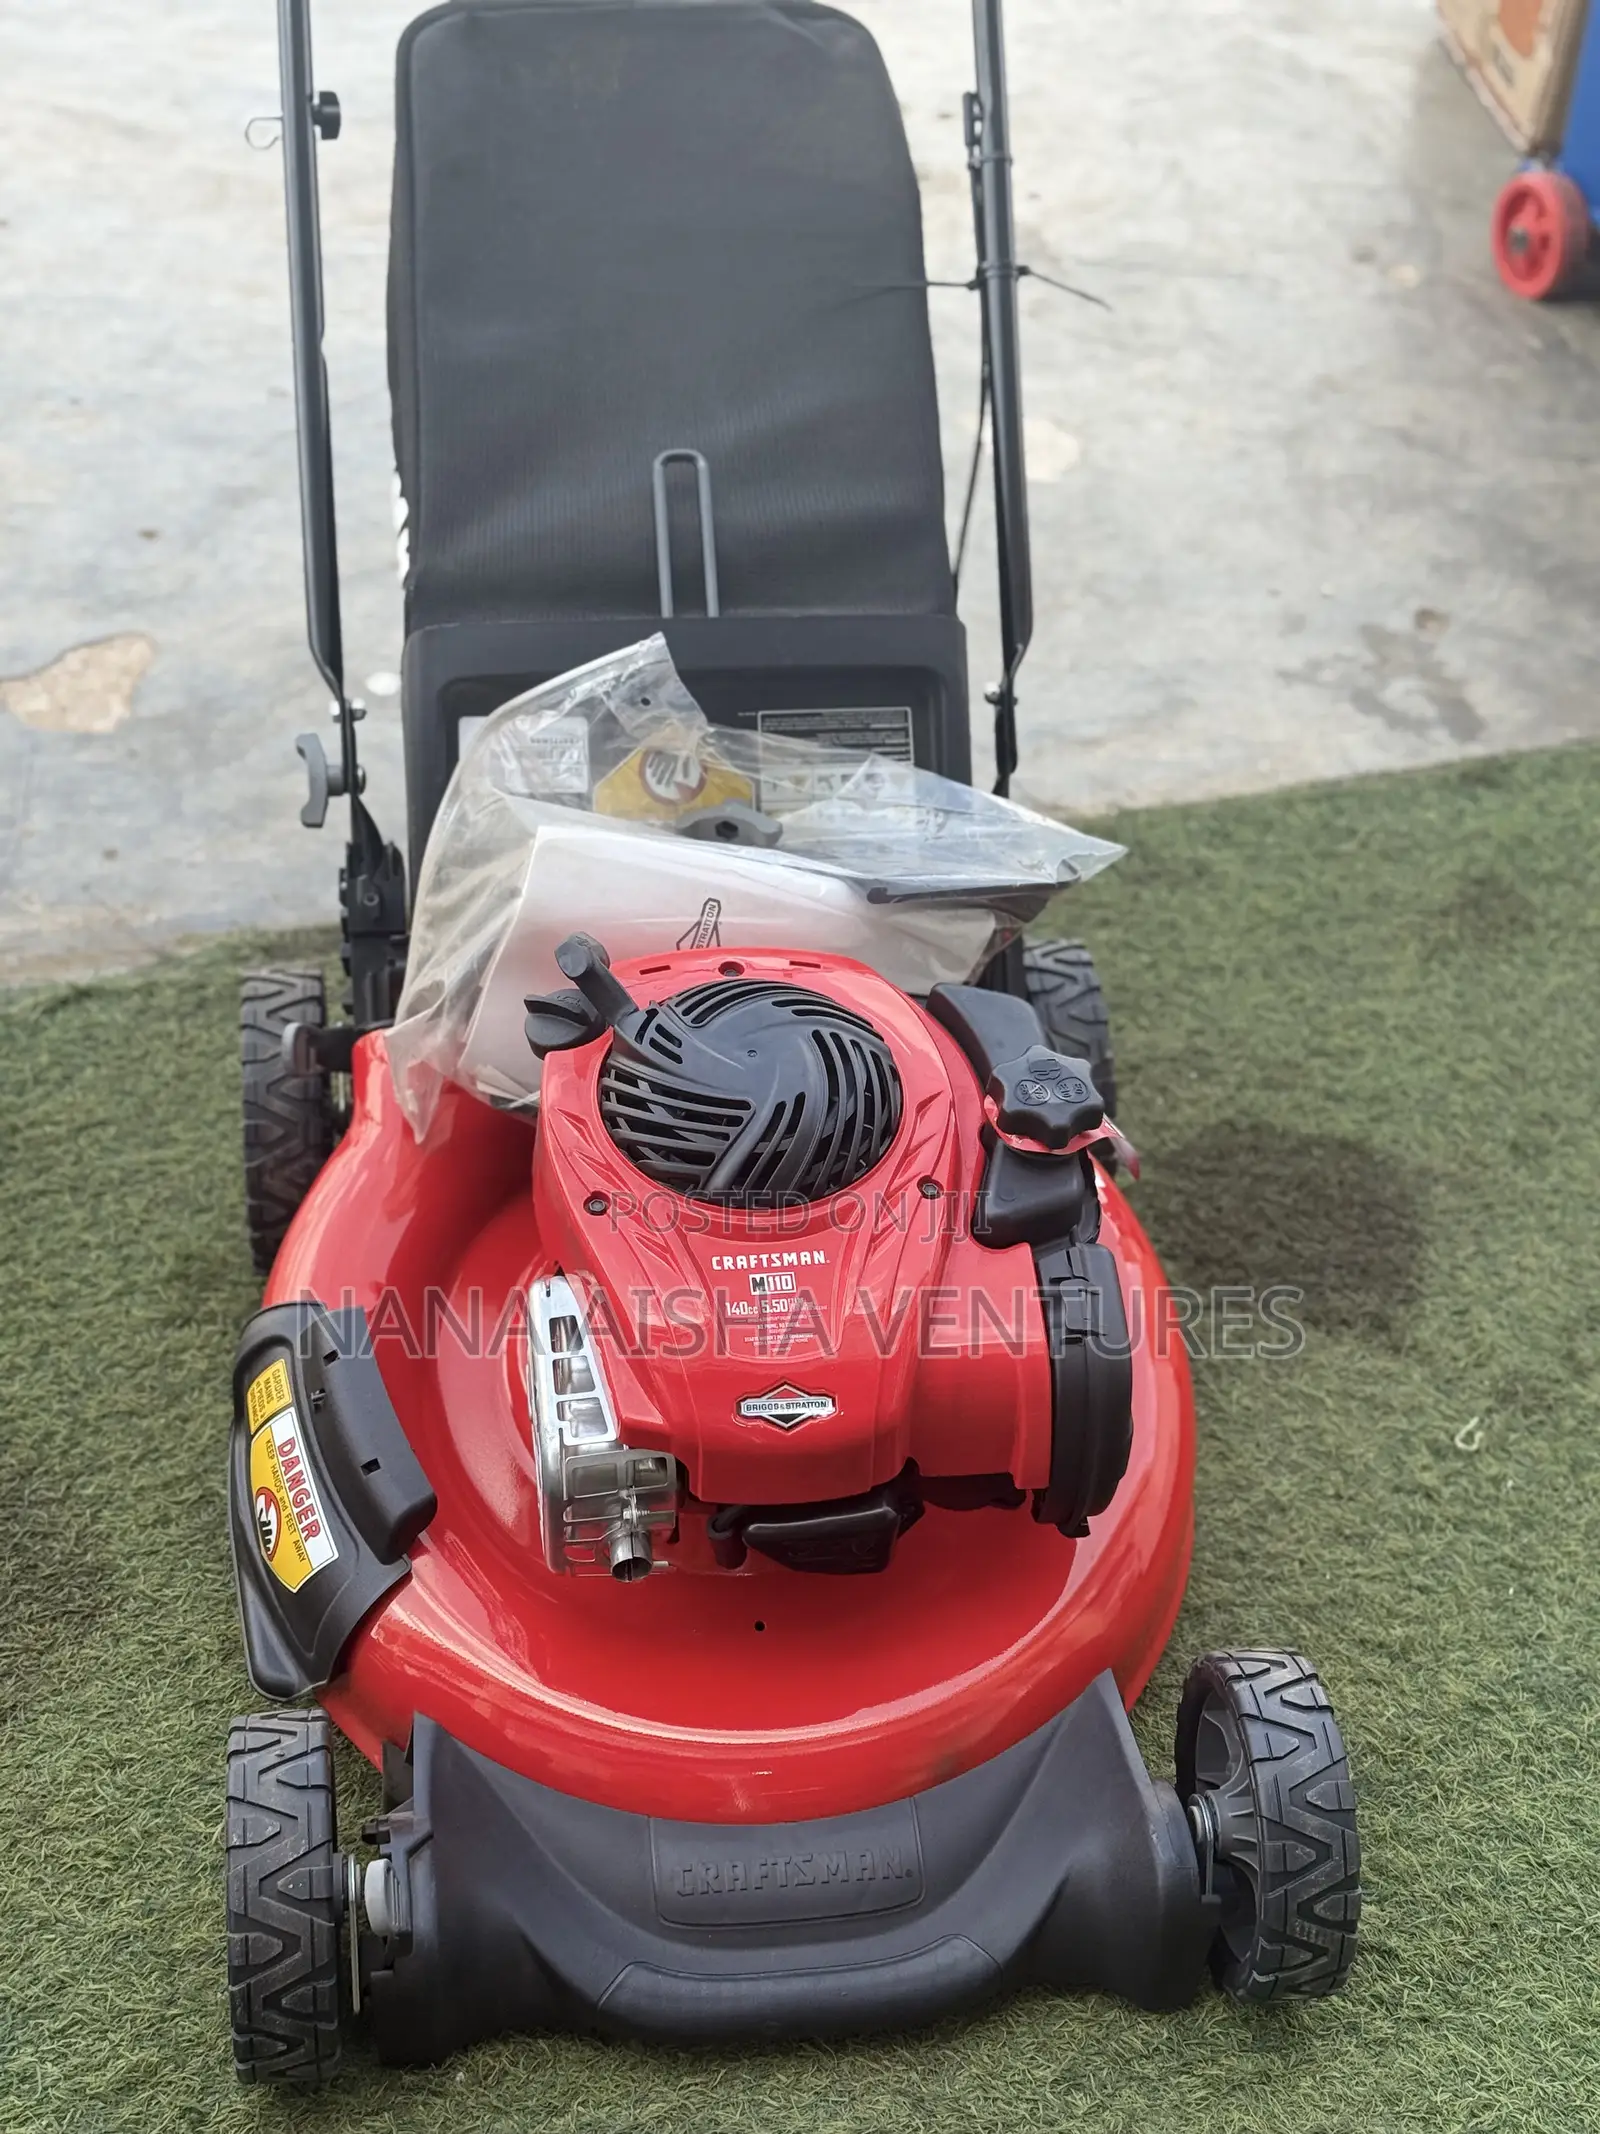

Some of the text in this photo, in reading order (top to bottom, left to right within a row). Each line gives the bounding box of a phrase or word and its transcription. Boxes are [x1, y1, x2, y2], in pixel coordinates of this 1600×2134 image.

[711, 1250, 827, 1271] CRAFTSMAN
[751, 1275, 793, 1293] M110
[725, 1301, 759, 1316] 140cc
[761, 1298, 789, 1314] 5.50
[265, 1439, 307, 1563] KEEP HANDS and FEET AWAY
[277, 1436, 322, 1544] DANGER
[676, 1849, 907, 1898] CRAFTSMAN
